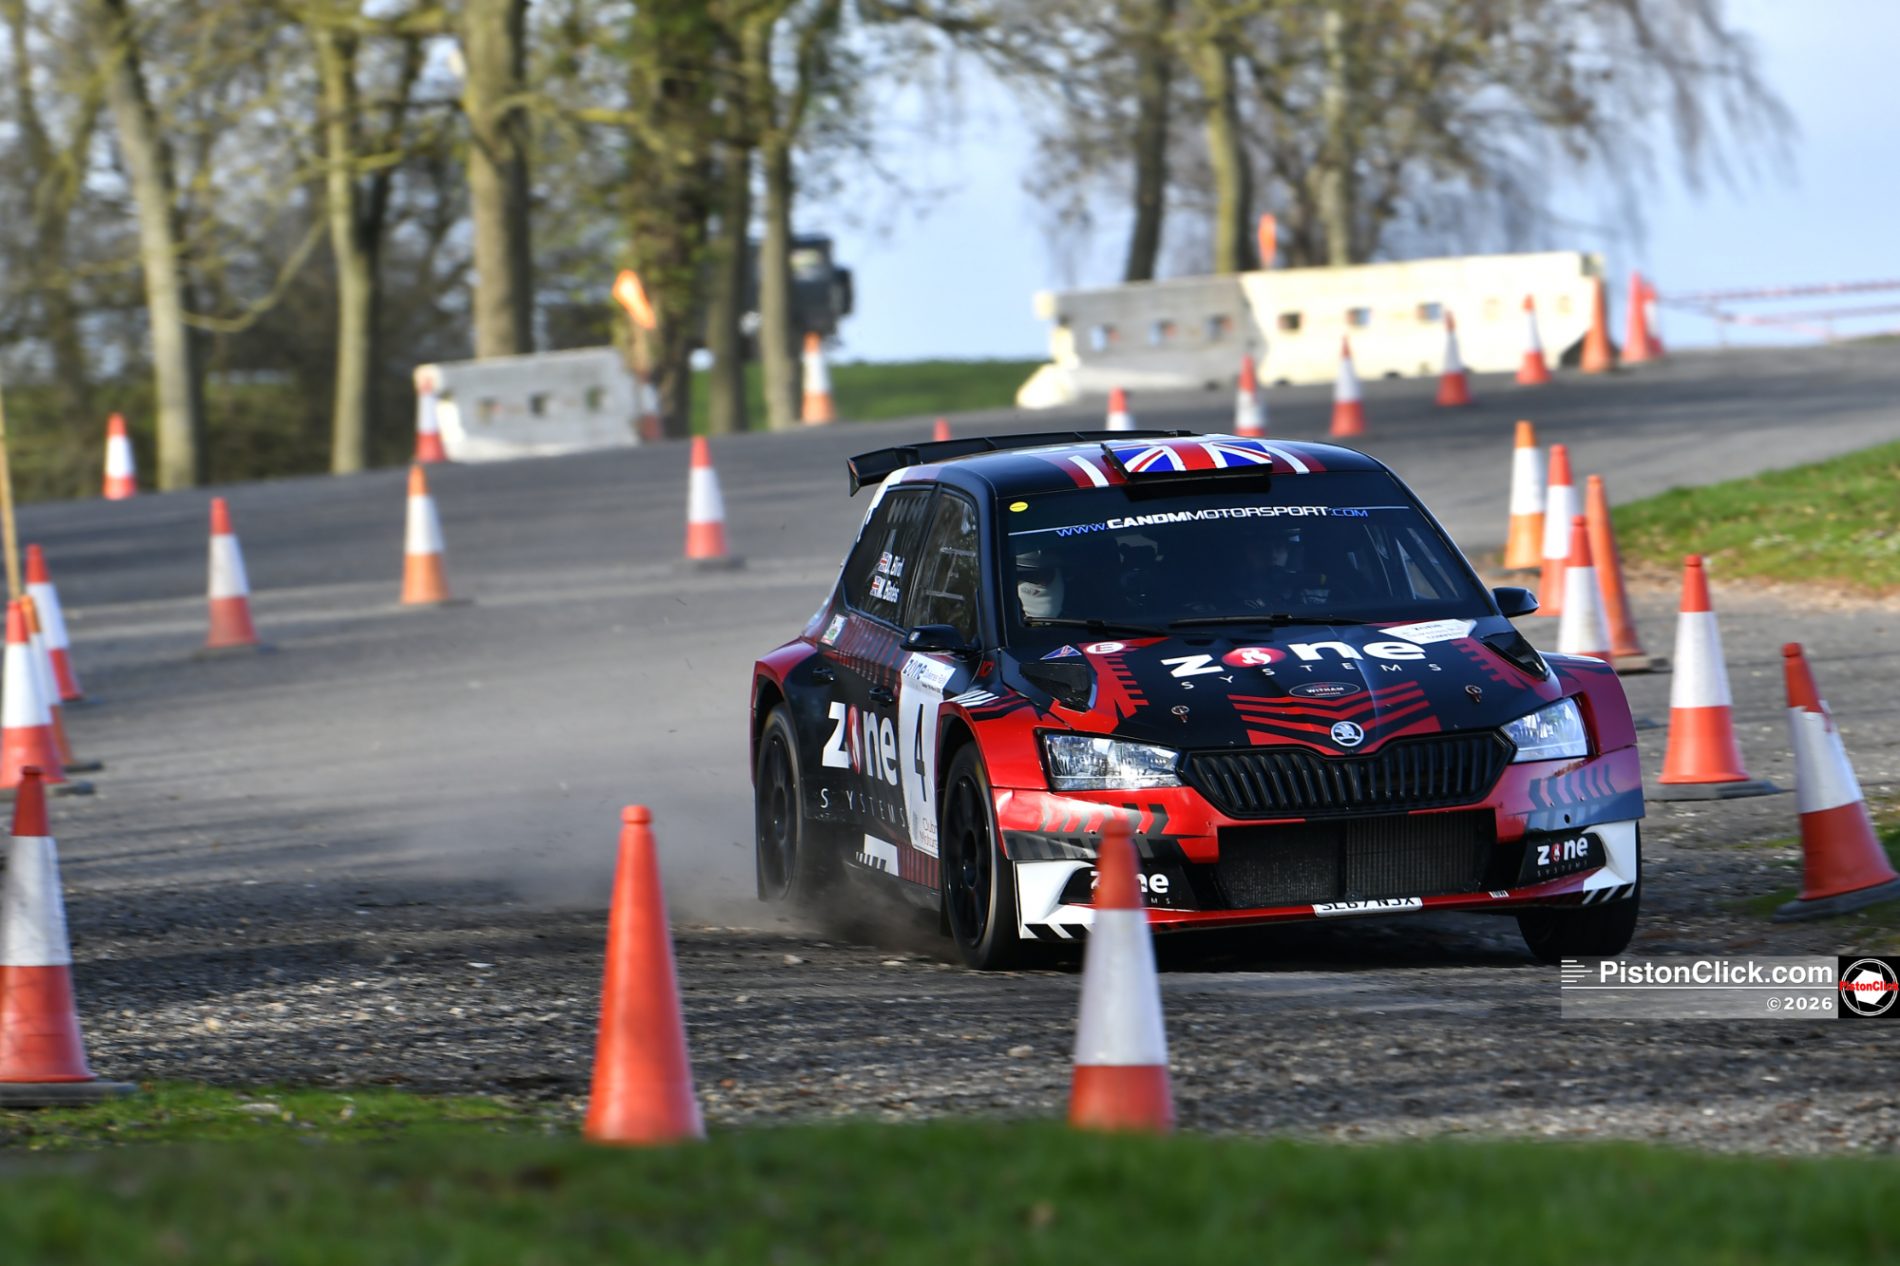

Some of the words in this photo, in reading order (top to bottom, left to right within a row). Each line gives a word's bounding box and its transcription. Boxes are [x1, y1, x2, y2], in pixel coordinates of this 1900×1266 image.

[1160, 641, 1427, 678] zone
[1181, 663, 1443, 690] SYSTEMS
[822, 701, 898, 786] zone
[914, 703, 926, 802] 4
[821, 788, 905, 828] SYSTEMS
[1537, 837, 1588, 866] zone
[1090, 870, 1169, 894] zne
